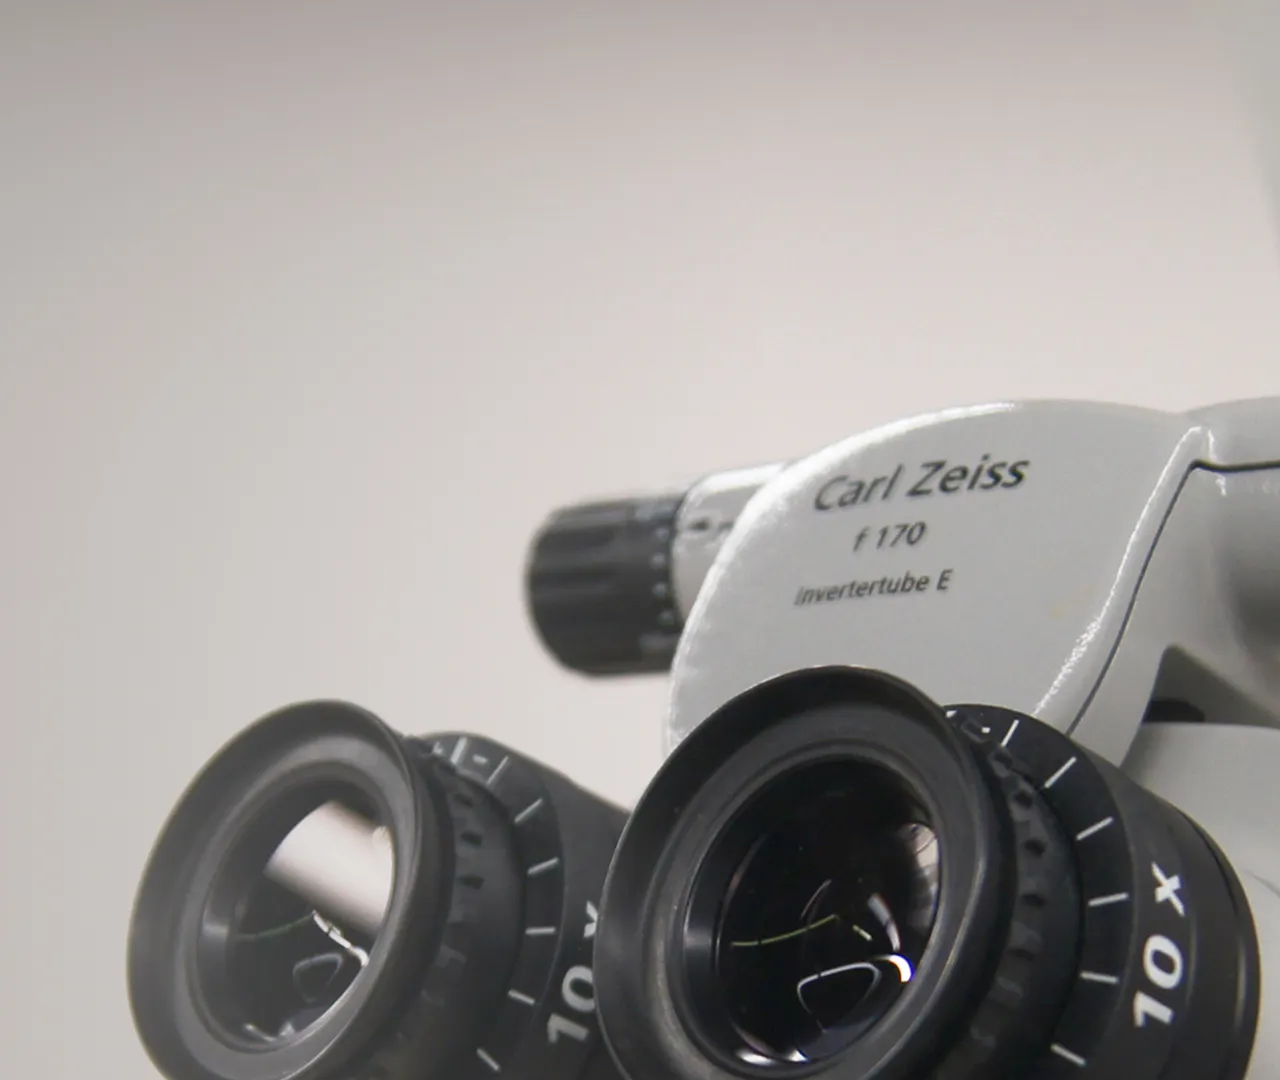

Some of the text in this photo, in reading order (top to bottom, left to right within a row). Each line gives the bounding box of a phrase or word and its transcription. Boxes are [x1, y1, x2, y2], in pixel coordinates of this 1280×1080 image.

[814, 453, 1030, 511] Carl Zeiss
[876, 521, 927, 549] 170
[936, 569, 954, 591] E
[547, 965, 596, 1043] 10
[1133, 935, 1184, 1028] 10
